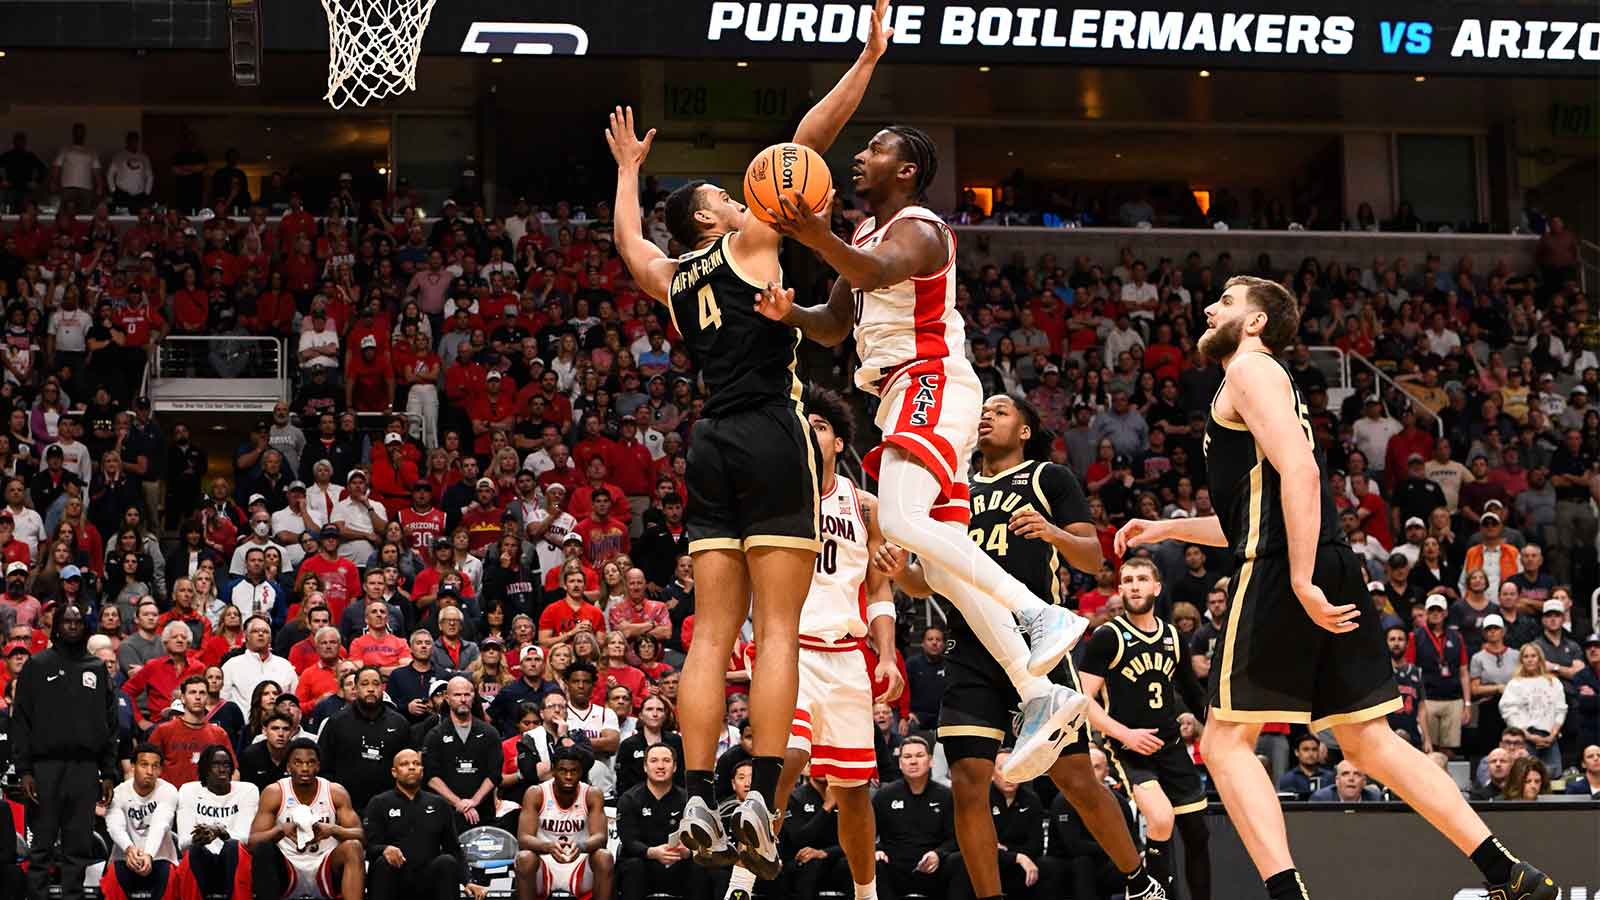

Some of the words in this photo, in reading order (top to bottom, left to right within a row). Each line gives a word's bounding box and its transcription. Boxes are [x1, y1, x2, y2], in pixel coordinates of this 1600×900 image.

[708, 2, 925, 44] PURDUE
[940, 7, 1354, 54] BOILERMAKERS
[1380, 22, 1432, 54] VS
[698, 283, 722, 331] 4
[911, 375, 940, 426] CATS
[1148, 682, 1163, 709] 3
[197, 803, 219, 818] LOCK
[220, 808, 230, 818] IT
[541, 819, 585, 832] ARIZONA
